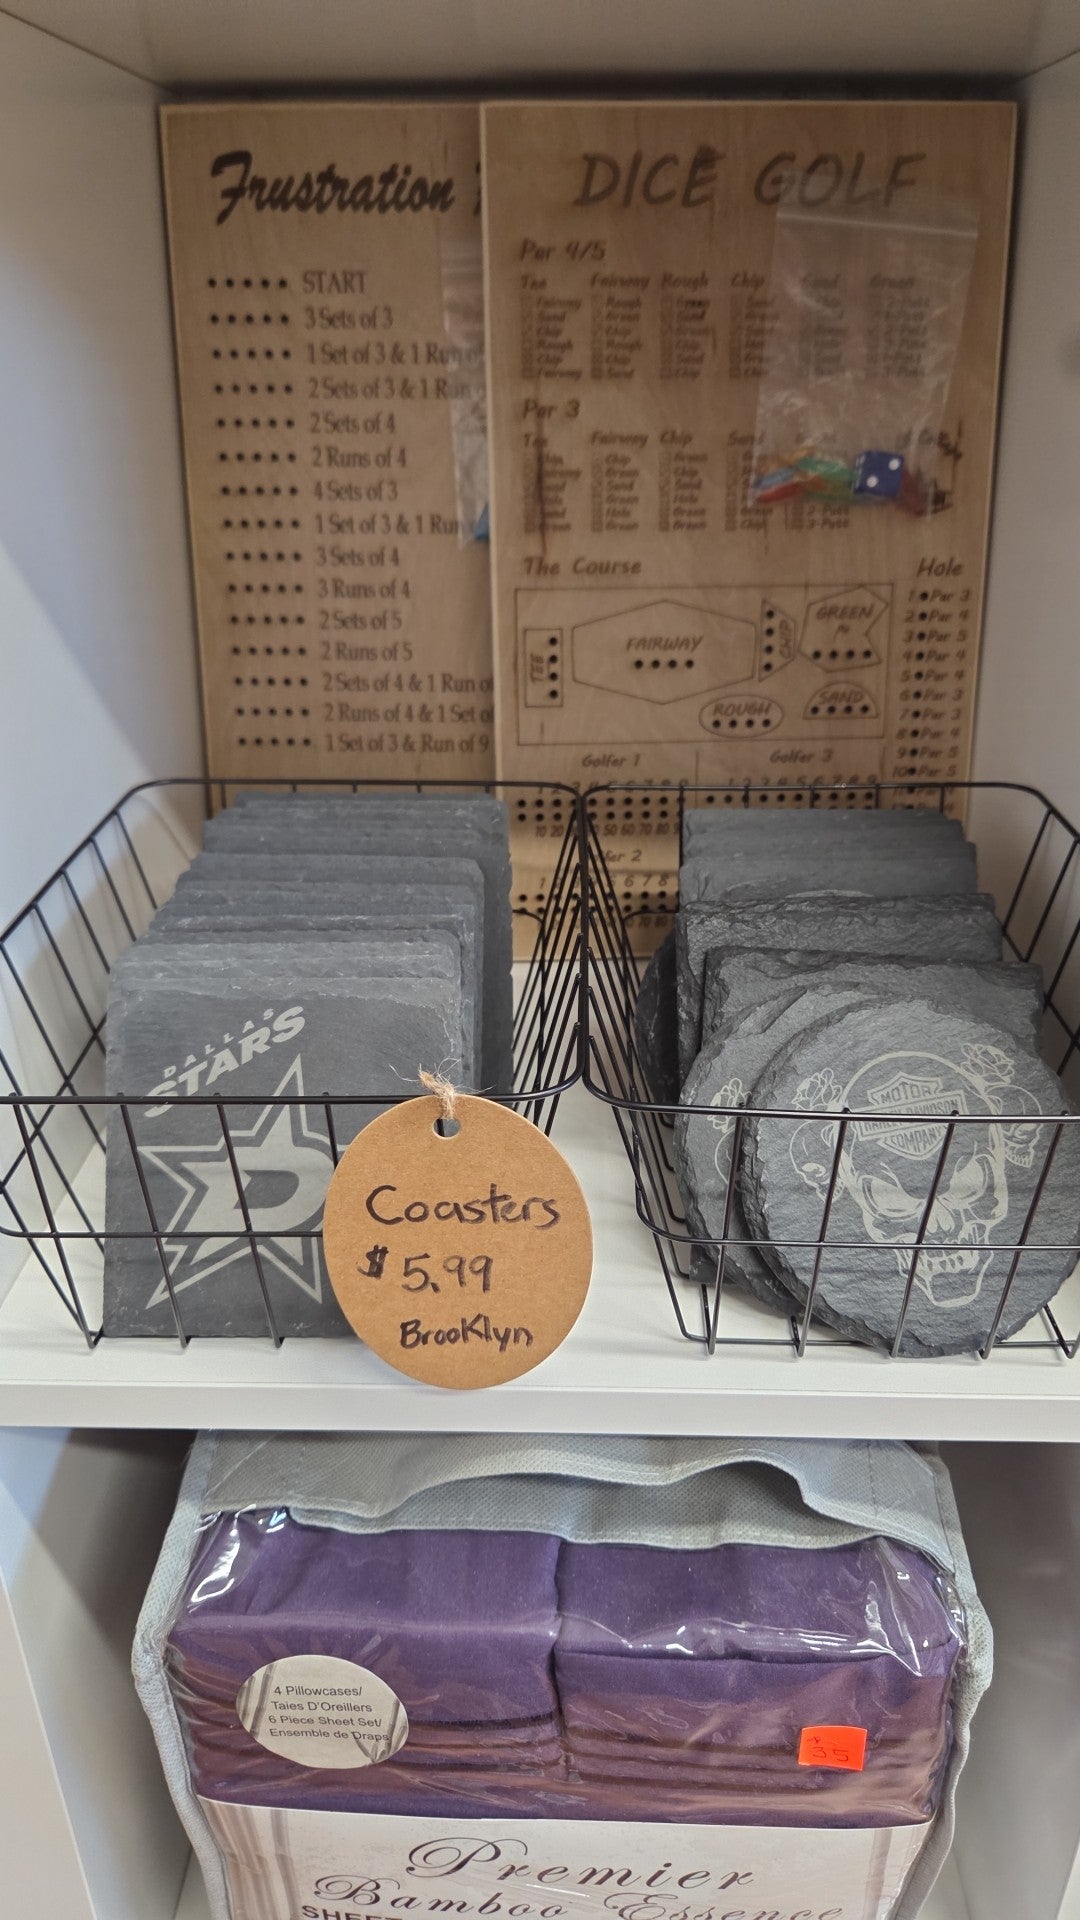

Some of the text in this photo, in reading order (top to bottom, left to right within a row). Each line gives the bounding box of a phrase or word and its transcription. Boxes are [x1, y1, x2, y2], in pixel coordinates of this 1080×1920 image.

[211, 150, 456, 226] Frustration
[573, 146, 927, 208] DICE GOLF
[520, 237, 556, 261] Par
[303, 269, 367, 294] START
[304, 304, 394, 330] 3 Sets of 3
[307, 340, 316, 366] 1
[320, 340, 347, 366] Set
[352, 340, 370, 366] of
[375, 340, 386, 366] 3
[390, 340, 406, 366] &
[411, 340, 420, 366] 1
[308, 376, 320, 400] 2
[322, 376, 358, 400] Sets
[362, 376, 380, 400] of
[385, 376, 396, 400] 3
[399, 376, 416, 400] &
[420, 376, 429, 400] 1
[522, 398, 581, 419] Par 3
[310, 410, 396, 434] 2 Sets of 4
[312, 444, 408, 468] 2 Runs of 4
[313, 478, 399, 501] 4 Sets of 3
[315, 512, 324, 536] 1
[328, 512, 355, 536] Set
[358, 512, 377, 536] of
[381, 512, 392, 536] 3
[396, 512, 411, 536] &
[415, 512, 424, 536] 1
[316, 545, 400, 568] 3 Sets of 4
[523, 556, 643, 576] The Course
[916, 556, 964, 577] Hole
[318, 577, 411, 600] 3 Runs of 4
[929, 588, 955, 603] Par
[319, 608, 403, 631] 2 Sets of 5
[816, 603, 876, 621] GREEN
[928, 608, 953, 623] Par
[626, 634, 704, 652] FAIRWAY
[927, 629, 952, 643] Par
[320, 640, 414, 662] 2 Runs of 5
[925, 649, 950, 662] Par
[530, 652, 545, 683] TEE
[322, 671, 333, 693] 2
[335, 671, 370, 693] Sets
[373, 671, 391, 693] of
[393, 671, 404, 693] 4
[408, 671, 424, 693] &
[427, 671, 436, 693] 1
[441, 671, 476, 693] Run
[323, 702, 335, 723] 2
[337, 702, 380, 723] Runs
[383, 702, 401, 723] of
[404, 702, 415, 723] 4
[418, 702, 433, 723] &
[437, 702, 446, 723] 1
[449, 702, 476, 723] Set
[712, 702, 772, 717] ROUGH
[922, 707, 946, 720] Par
[325, 732, 490, 754] 1 Set of 3 & Run of 9
[581, 753, 641, 768] Golfer 1
[770, 749, 833, 764] Golfer 3
[163, 1008, 274, 1079] DALLAS
[144, 1005, 306, 1118] STARS
[880, 1081, 933, 1105] MOTOR
[365, 1182, 561, 1230] Coasters
[357, 1244, 495, 1294] $ 5.99
[274, 1685, 364, 1698] 4 Pillowcases/
[272, 1701, 373, 1713] Taies D'Oreillers
[268, 1715, 383, 1728] 6 Piece Sheet Set/
[269, 1728, 391, 1743] Ensemble de Draps
[405, 1836, 754, 1890] Premier
[313, 1874, 843, 1920] Bamboo Essence
